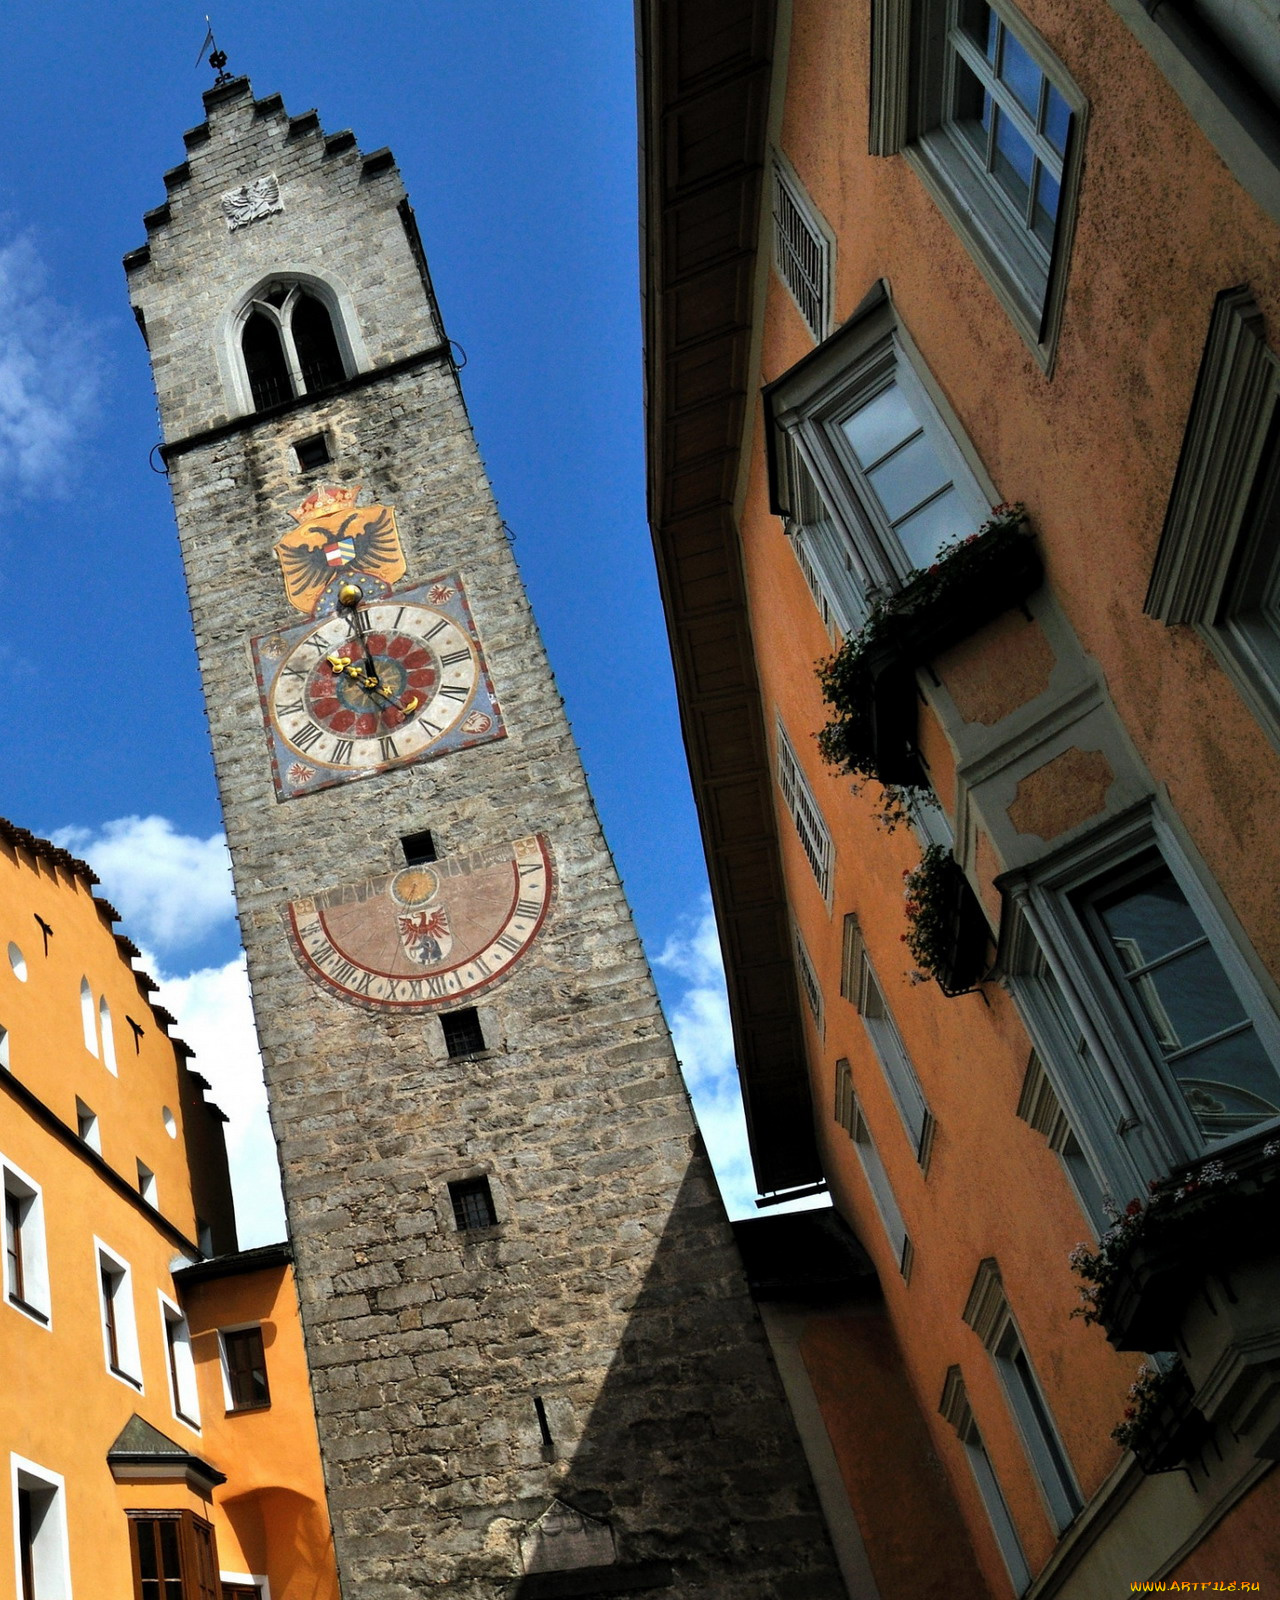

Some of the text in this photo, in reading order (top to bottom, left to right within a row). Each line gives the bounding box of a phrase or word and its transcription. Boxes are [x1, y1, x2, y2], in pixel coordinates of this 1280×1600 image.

[392, 606, 406, 629] I
[422, 619, 450, 642] II
[303, 632, 329, 655] XI
[440, 647, 472, 668] III
[283, 665, 310, 681] X
[439, 684, 470, 704] IV
[275, 698, 304, 716] IX
[289, 721, 324, 753] VIII
[418, 718, 444, 737] V
[330, 739, 354, 765] VII
[378, 736, 400, 761] VI
[518, 863, 544, 878] V
[515, 898, 542, 920] IIII
[496, 934, 525, 955] III
[475, 957, 492, 977] II
[355, 972, 377, 995] IX
[386, 980, 400, 1001] X
[408, 979, 423, 999] XI
[425, 975, 447, 997] XII
[452, 971, 464, 989] I
